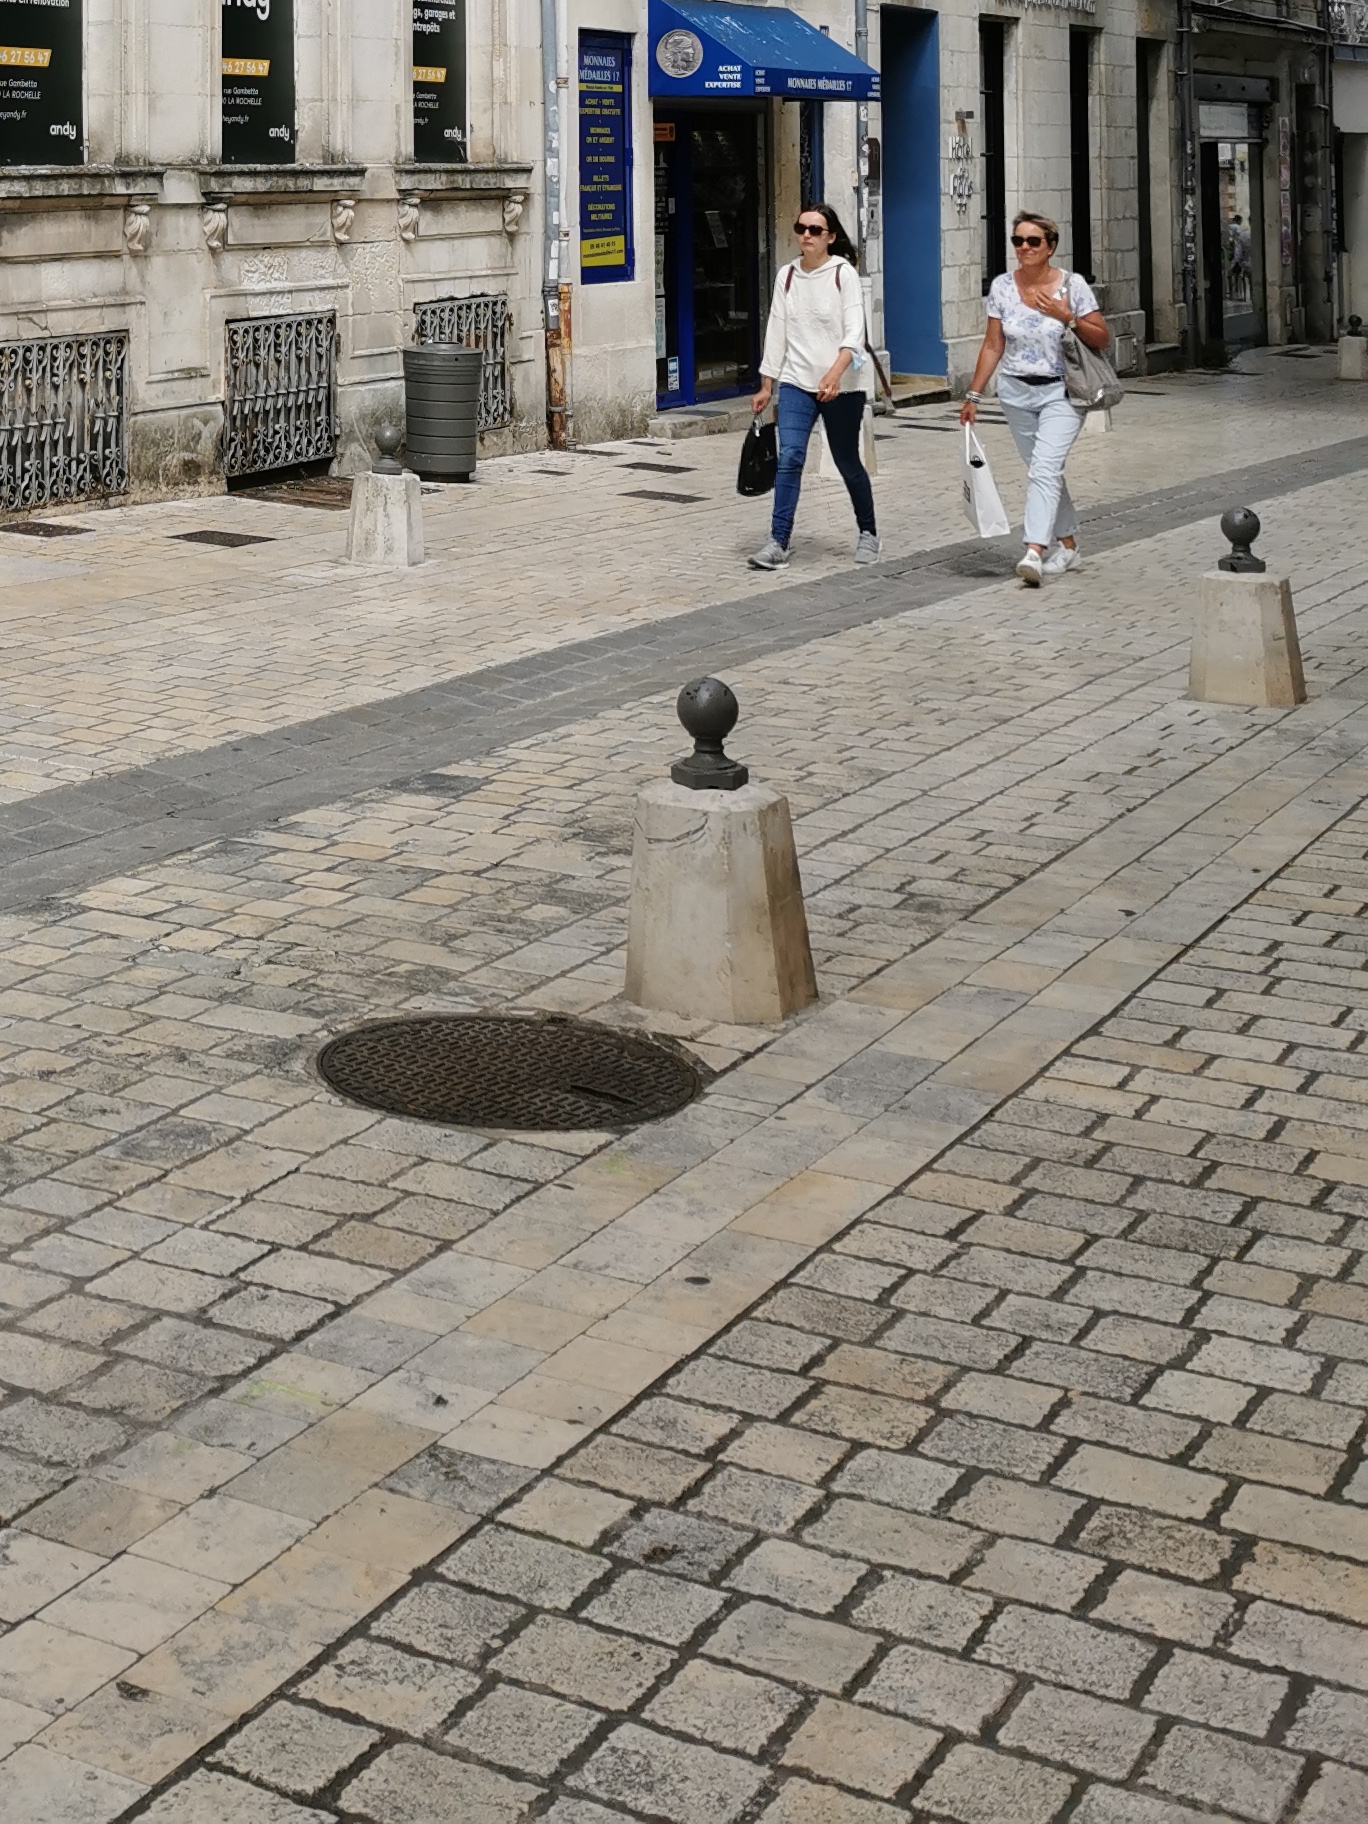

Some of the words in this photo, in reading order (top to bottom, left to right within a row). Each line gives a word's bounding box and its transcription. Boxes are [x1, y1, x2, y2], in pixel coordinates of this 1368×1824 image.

[424, 9, 448, 21] garages
[449, 10, 456, 20] et
[10, 50, 22, 63] 27
[23, 51, 35, 64] 56
[37, 52, 49, 65] 47
[583, 55, 616, 67] MONNAIES
[234, 61, 245, 73] 27
[246, 62, 256, 74] 56
[257, 62, 268, 74] 47
[717, 64, 742, 72] ACHAT
[418, 69, 427, 80] 27
[427, 70, 436, 80] 56
[436, 70, 446, 80] 47
[579, 67, 611, 81] MÉDAILLES
[612, 70, 620, 81] 17
[8, 78, 38, 88] Gambetta
[787, 77, 816, 90] MONNAIES
[817, 76, 846, 91] MÉDAILLES
[846, 80, 853, 91] 17
[2, 90, 11, 99] LA
[12, 90, 42, 100] ROCHELLE
[233, 86, 259, 95] Gambetta
[228, 97, 235, 105] LA
[236, 97, 263, 106] ROCHELLE
[49, 120, 77, 140] andy
[268, 124, 290, 142] andy
[443, 125, 462, 142] andy
